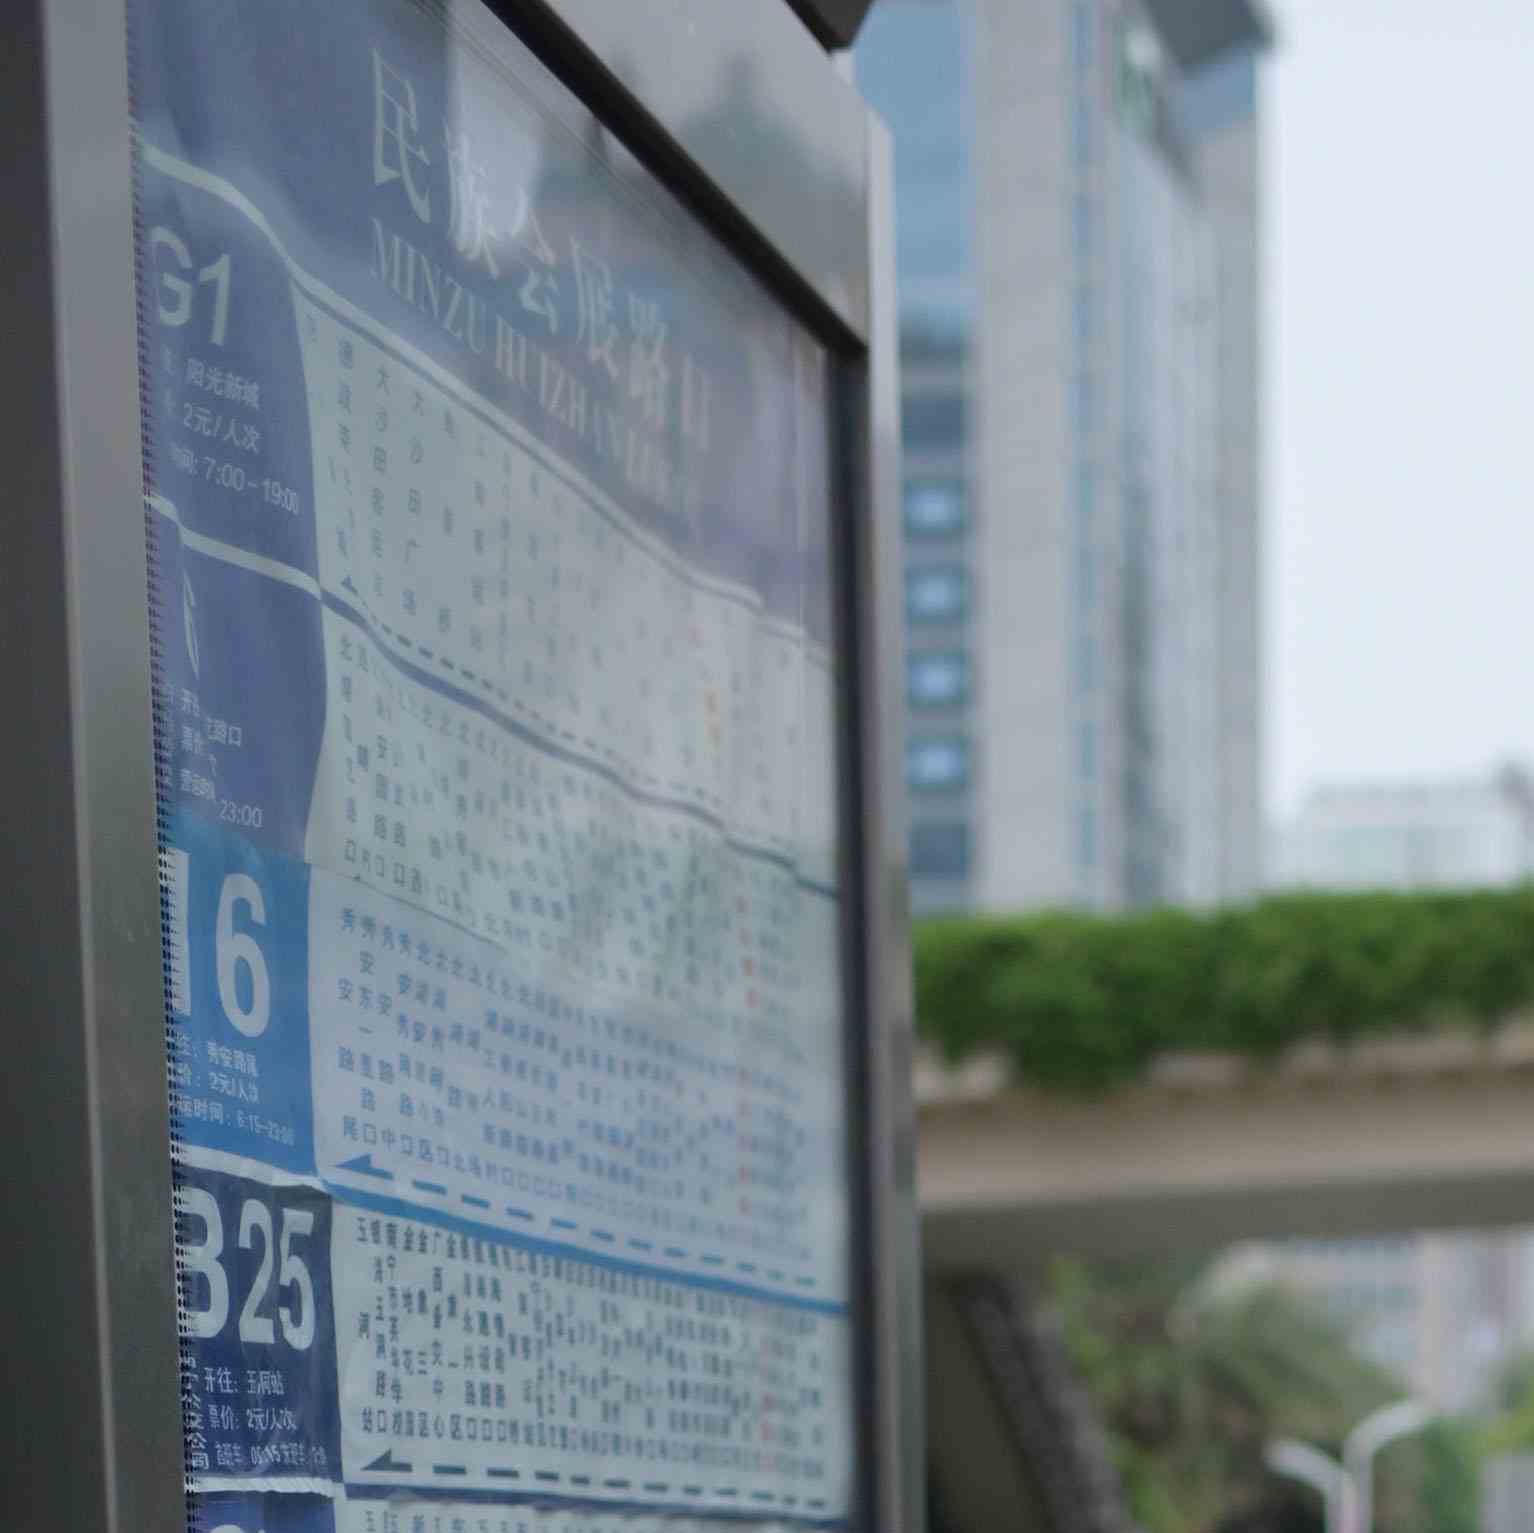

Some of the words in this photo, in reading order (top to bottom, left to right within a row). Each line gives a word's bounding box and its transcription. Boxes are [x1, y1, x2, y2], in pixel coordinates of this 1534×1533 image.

[151, 225, 232, 347] G1
[183, 402, 261, 453] 2元/人次
[178, 1184, 316, 1351] B25
